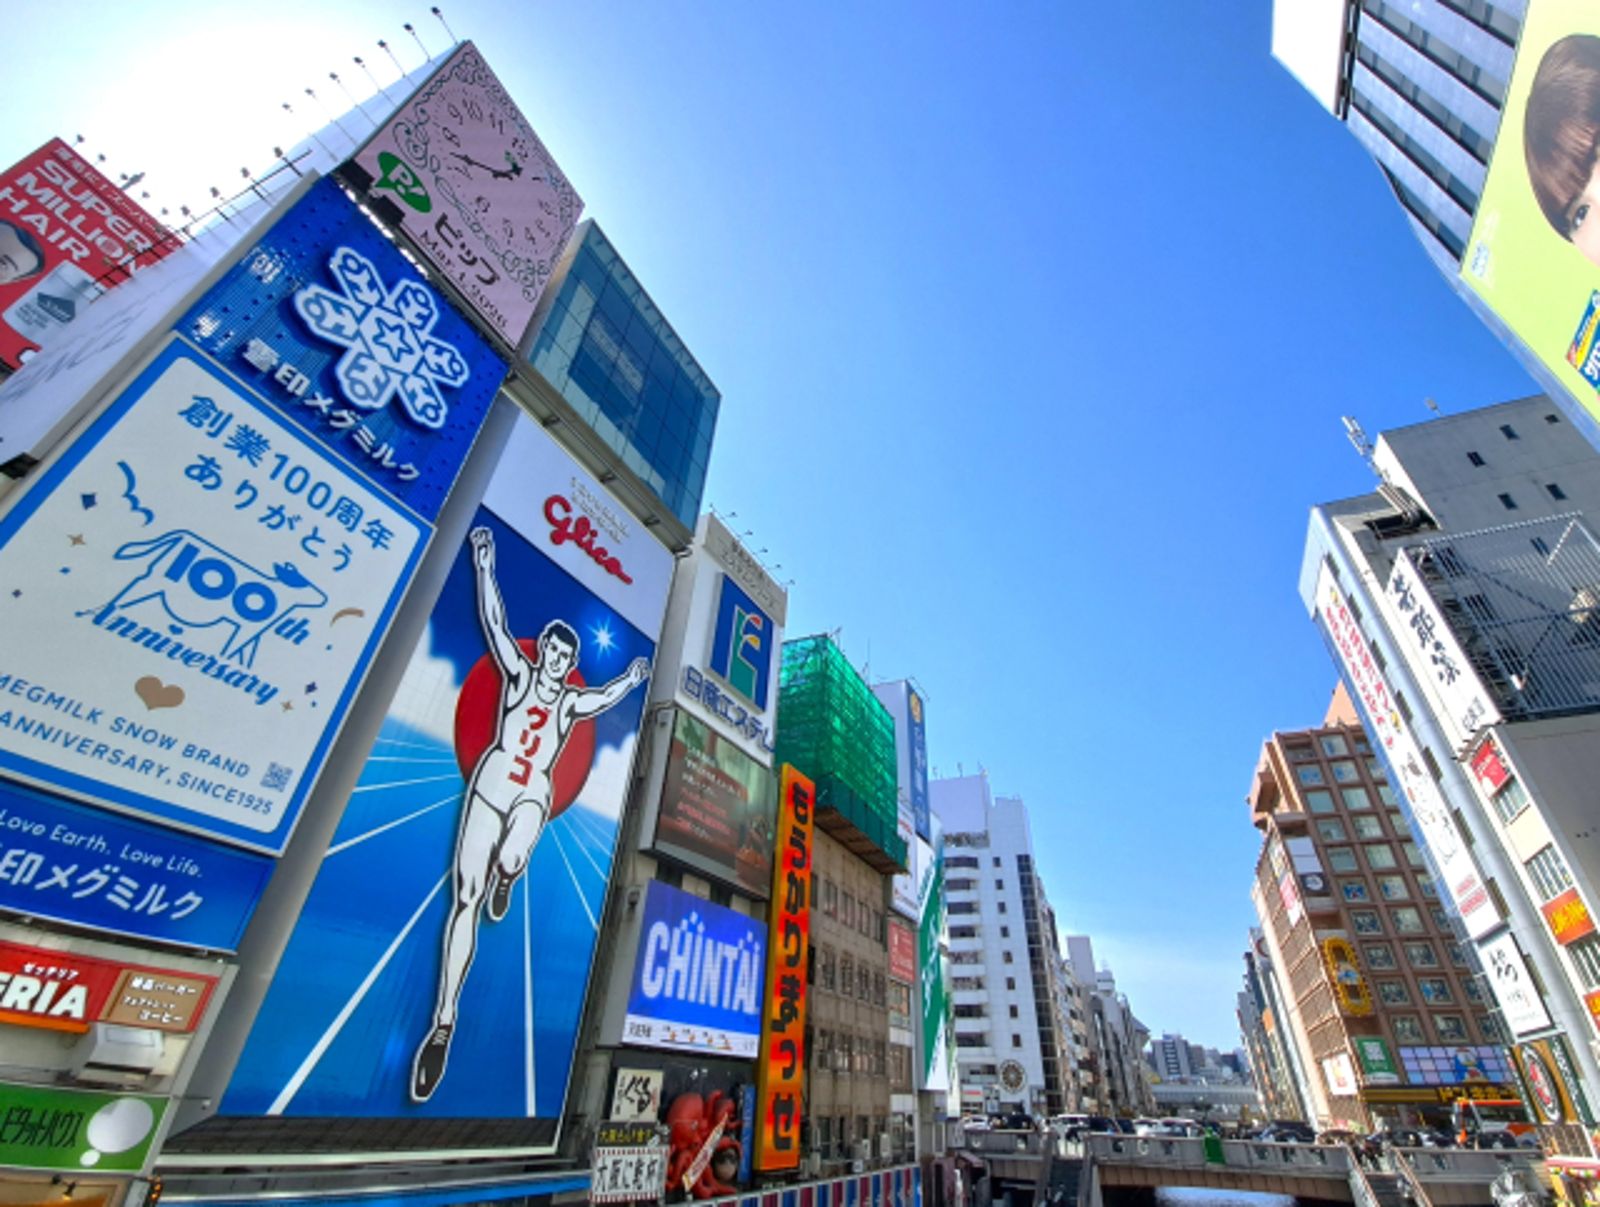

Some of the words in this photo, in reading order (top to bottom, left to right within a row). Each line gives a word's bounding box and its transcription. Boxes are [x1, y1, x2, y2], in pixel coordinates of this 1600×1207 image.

[0, 186, 91, 261] HAIR
[16, 172, 147, 275] MILLION
[36, 158, 154, 253] SUPER
[243, 338, 421, 482] 雪印メグミルク
[178, 394, 396, 551] 創業100周年
[184, 453, 355, 572] ありがとう
[75, 602, 278, 706] Anniversary
[109, 715, 178, 751] SNOW
[182, 743, 251, 779] BRAND
[508, 704, 553, 788] グリコ
[0, 809, 46, 837] Love
[49, 823, 111, 856] Earth.
[119, 843, 164, 869] Love
[166, 854, 203, 879] Life.
[0, 844, 203, 921] 印メグミルク
